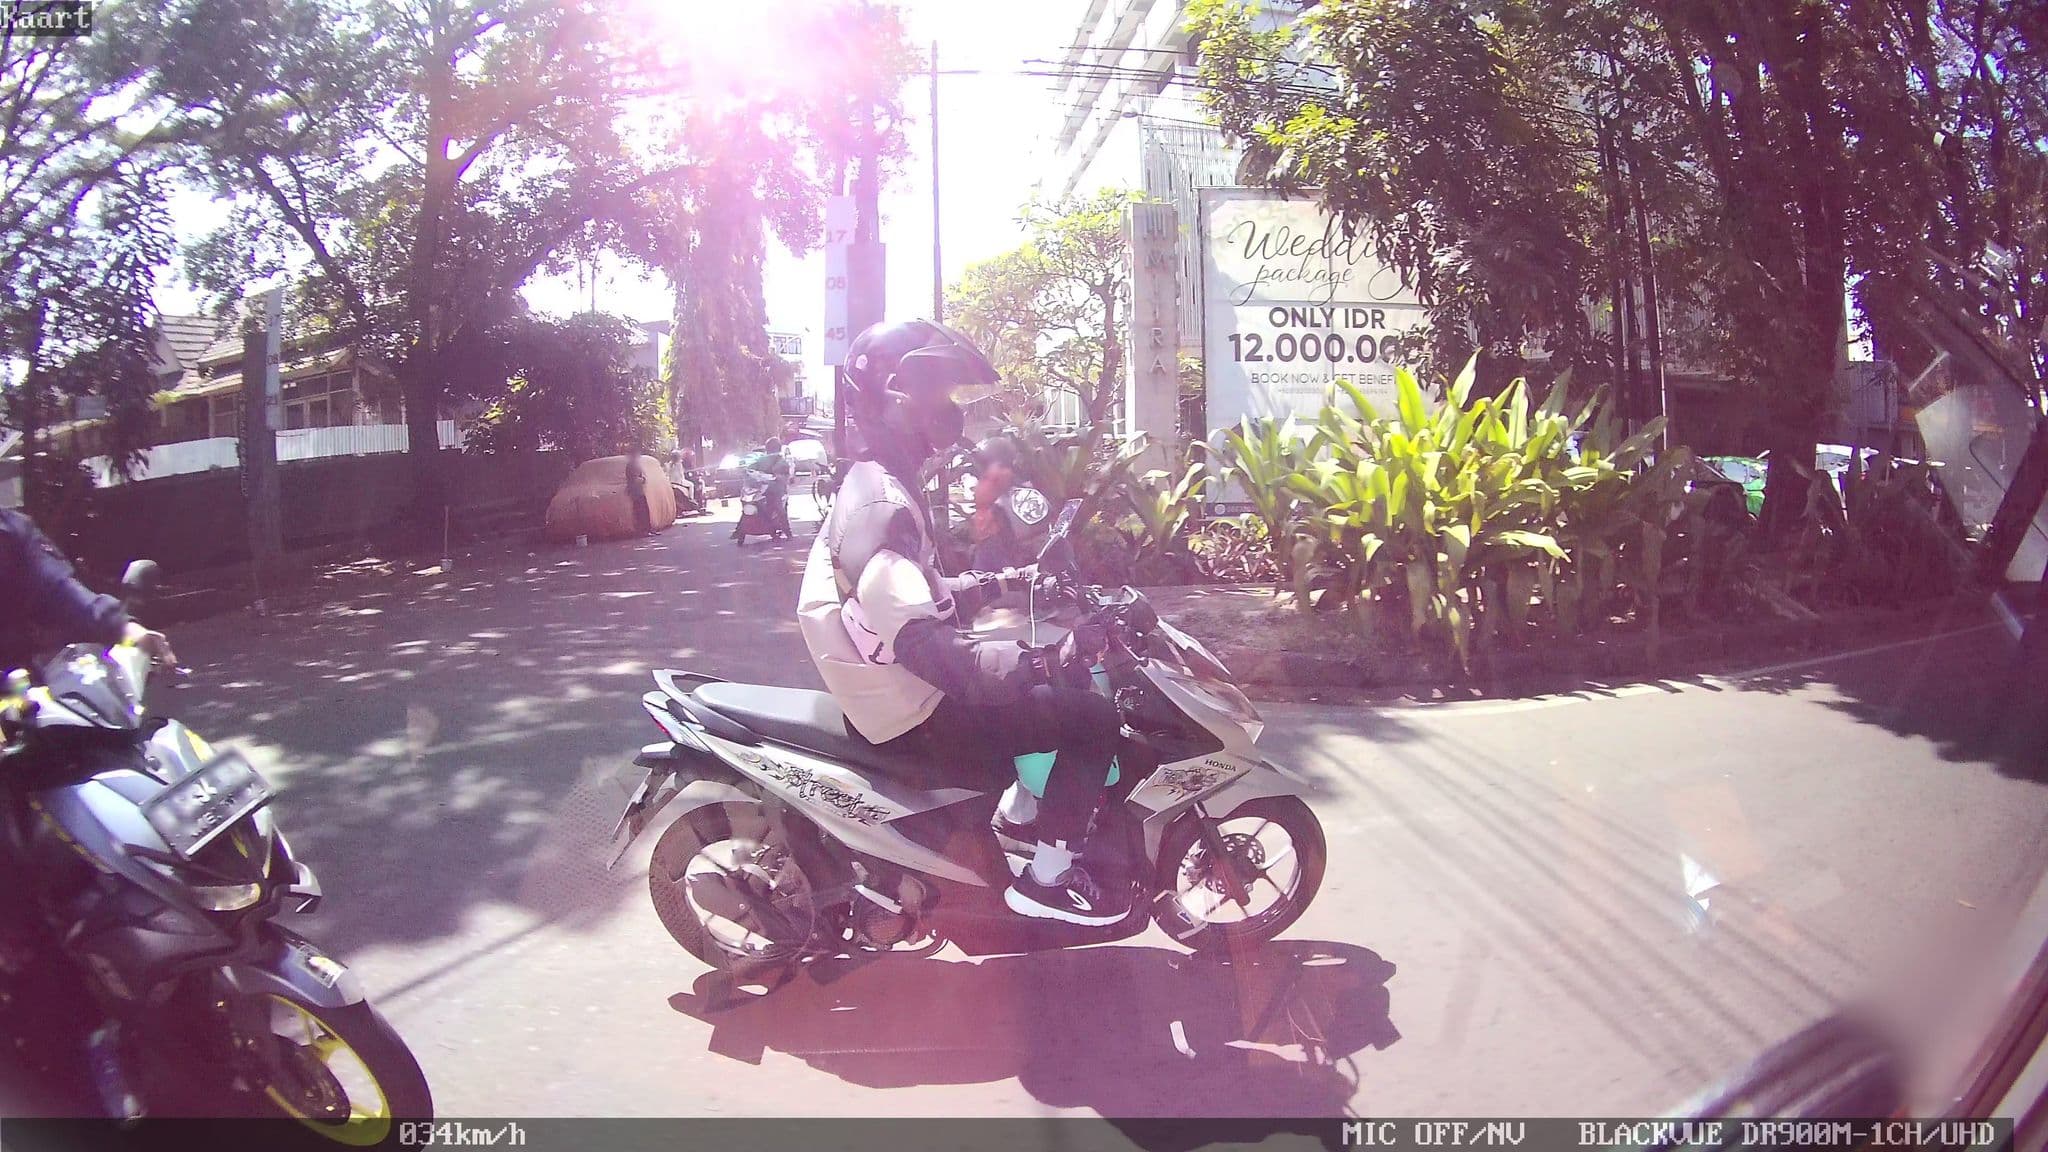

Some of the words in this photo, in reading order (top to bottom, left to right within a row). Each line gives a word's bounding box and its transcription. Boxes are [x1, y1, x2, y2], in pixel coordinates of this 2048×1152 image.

[1230, 256, 1354, 306] package
[1269, 307, 1334, 328] ONLY
[1344, 308, 1386, 329] IDR
[825, 327, 846, 340] 45
[1251, 373, 1288, 384] BOOK
[1291, 373, 1319, 384] NOW
[1359, 374, 1397, 385] BENEFI
[1204, 759, 1237, 772] HONDA
